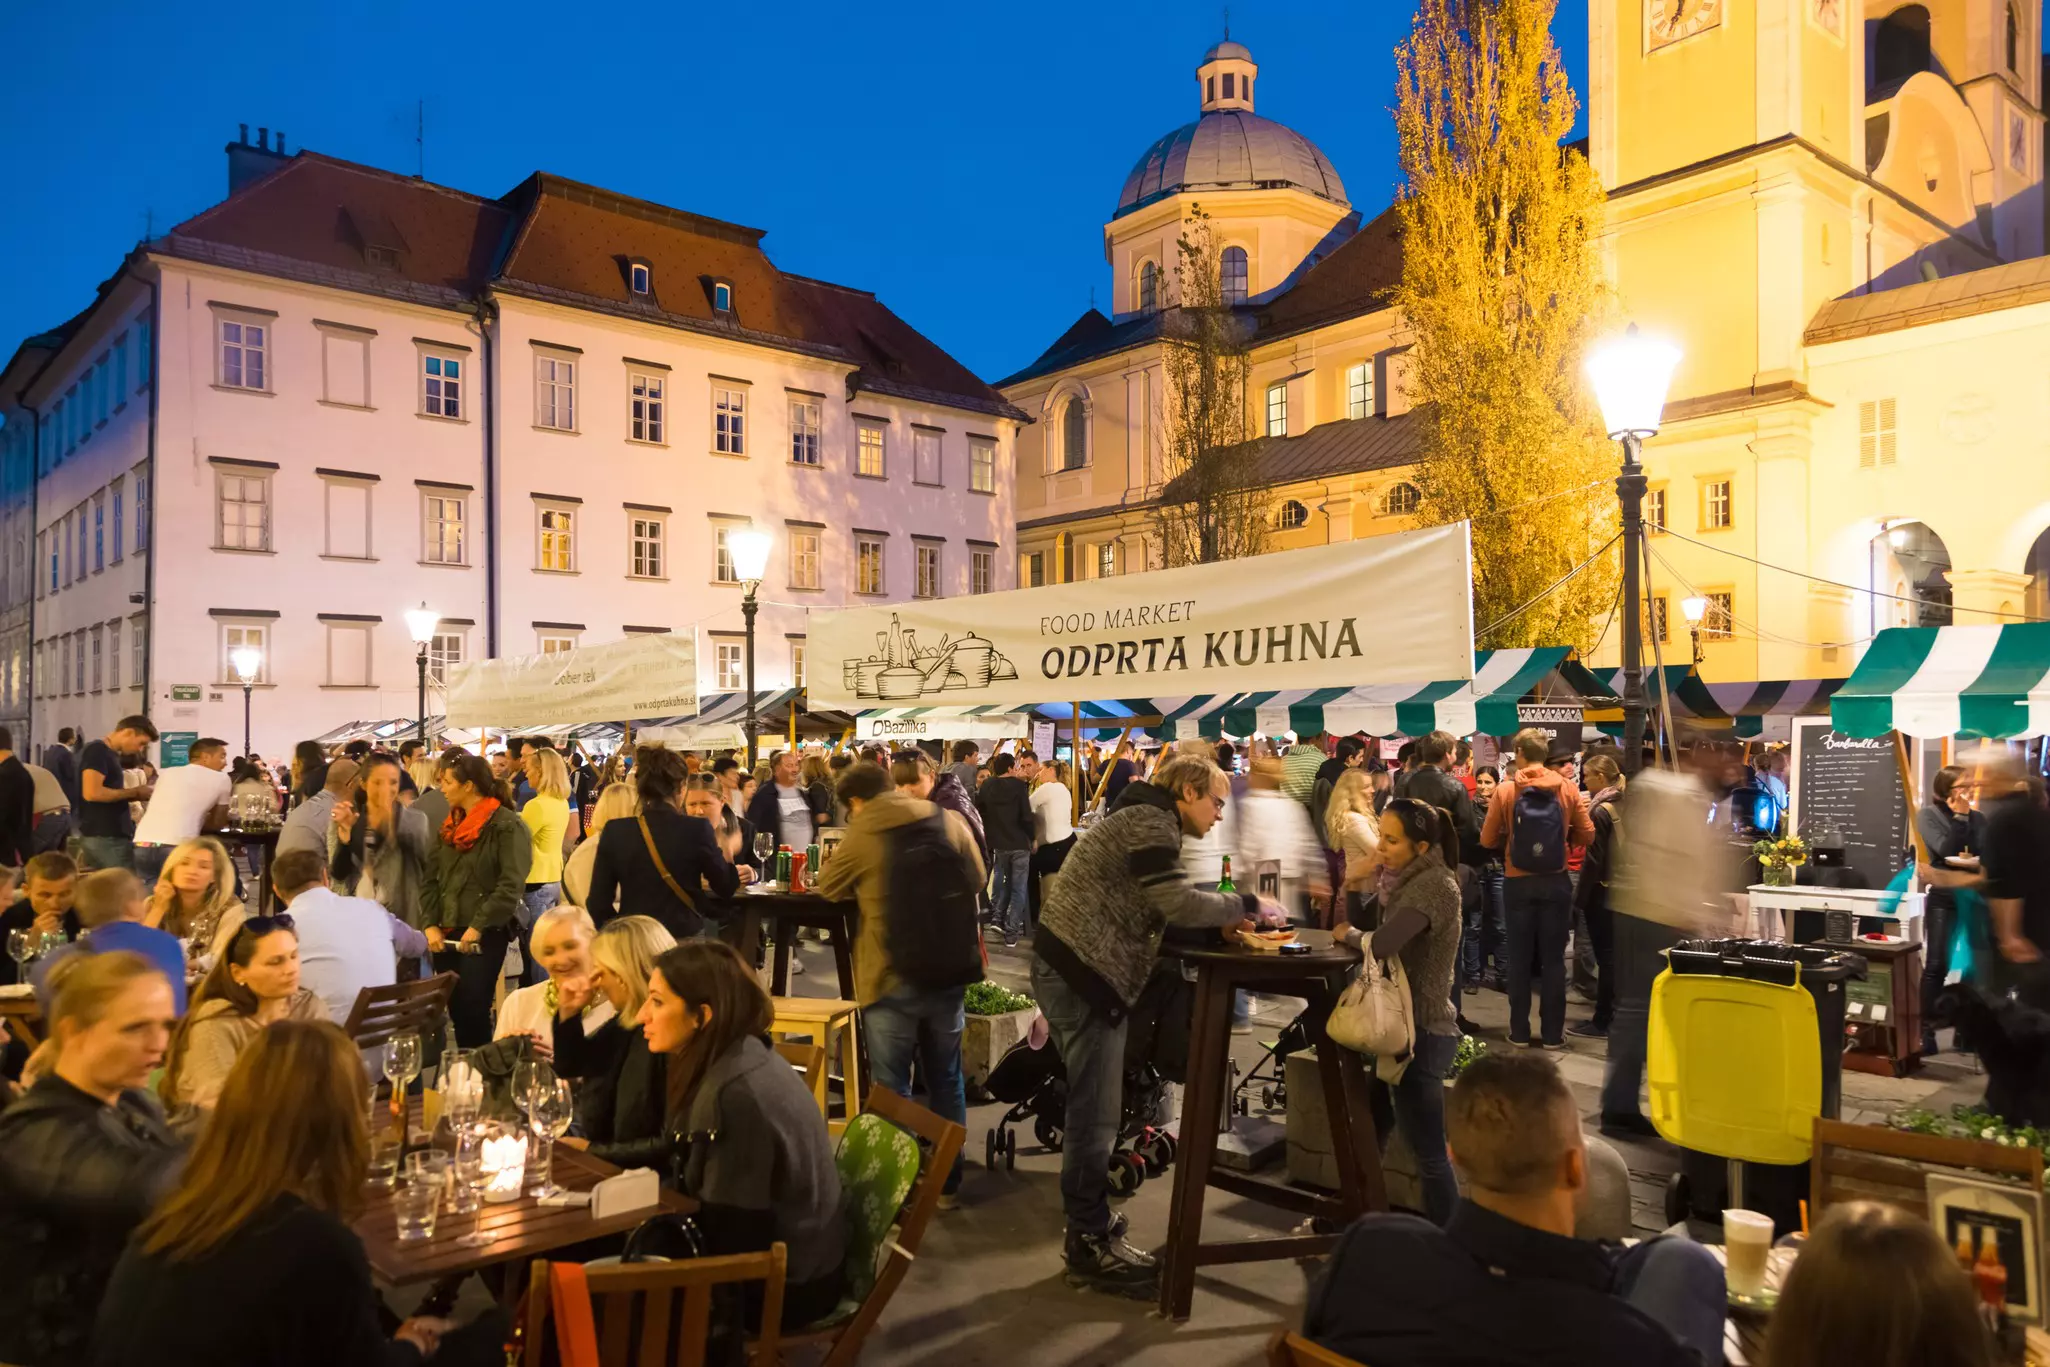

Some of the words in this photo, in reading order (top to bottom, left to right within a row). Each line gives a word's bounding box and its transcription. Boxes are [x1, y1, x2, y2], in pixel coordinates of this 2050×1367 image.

[1040, 612, 1096, 636] FOOD
[1104, 600, 1196, 630] MARKET
[1041, 635, 1189, 680] ODPRTA
[1202, 617, 1364, 669] KUHNA
[884, 719, 927, 735] Bazilika
